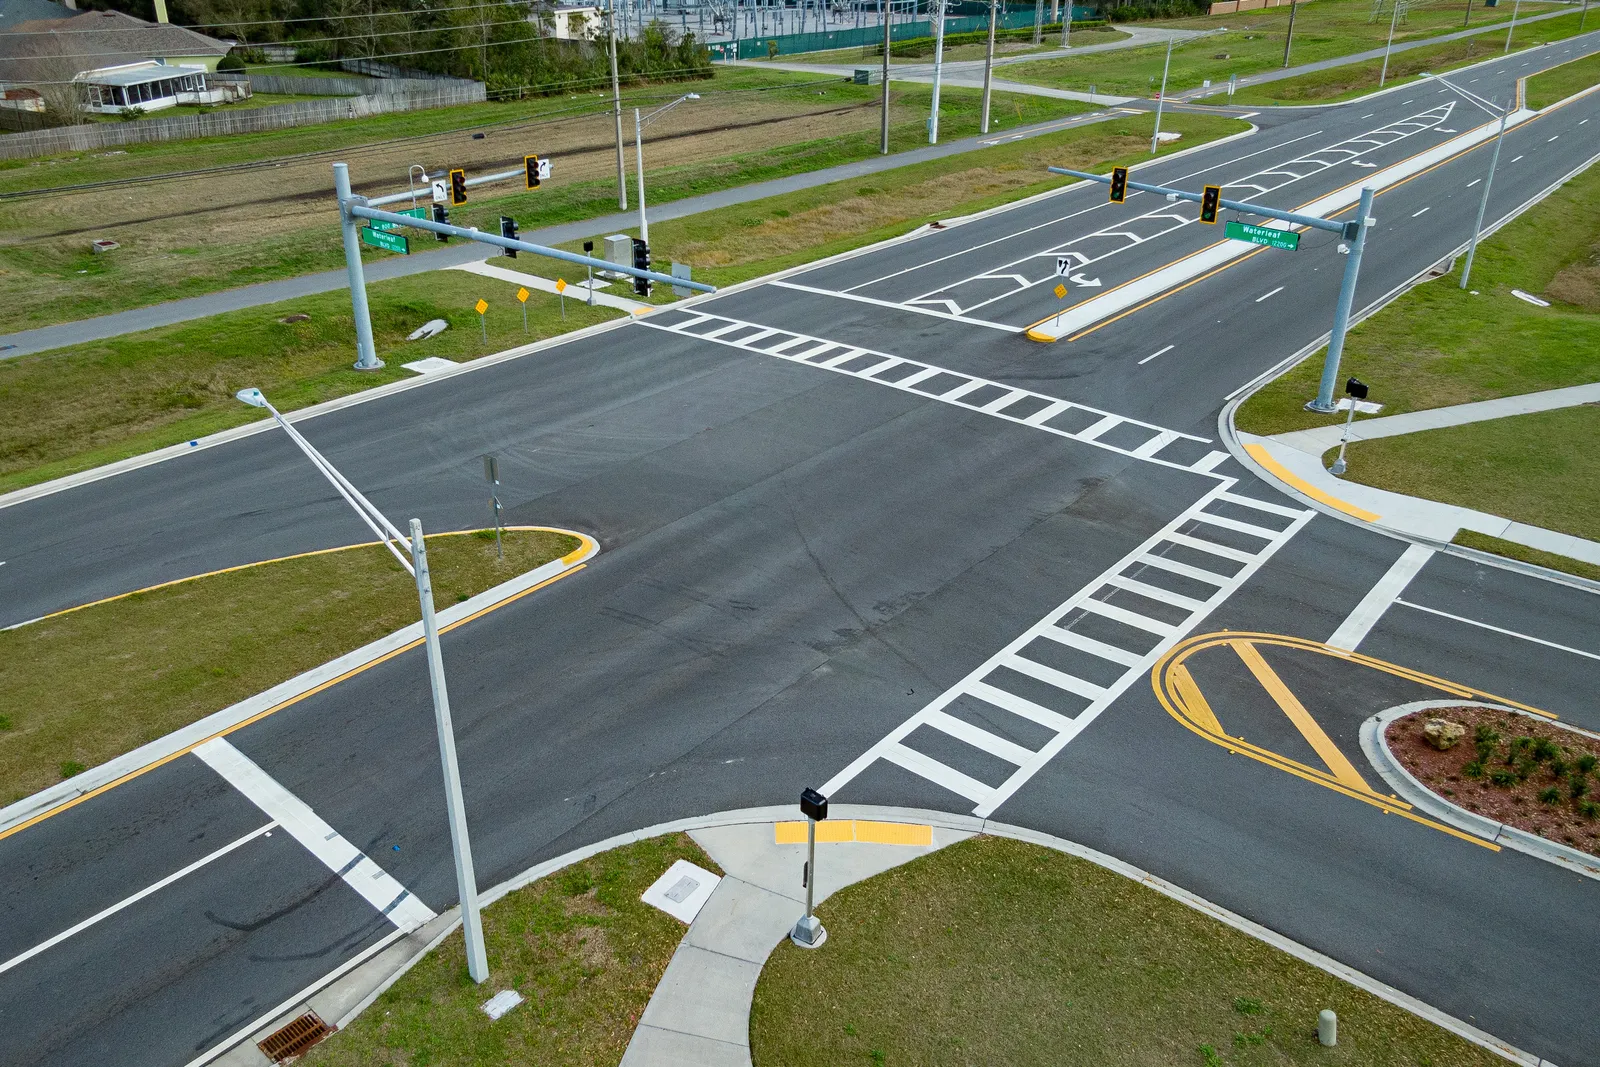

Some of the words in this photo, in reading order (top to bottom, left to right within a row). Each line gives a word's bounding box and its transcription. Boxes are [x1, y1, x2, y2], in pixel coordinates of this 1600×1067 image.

[372, 231, 396, 243] Waterleaf
[1243, 225, 1281, 239] Waterleaf
[1251, 236, 1268, 244] BLVD
